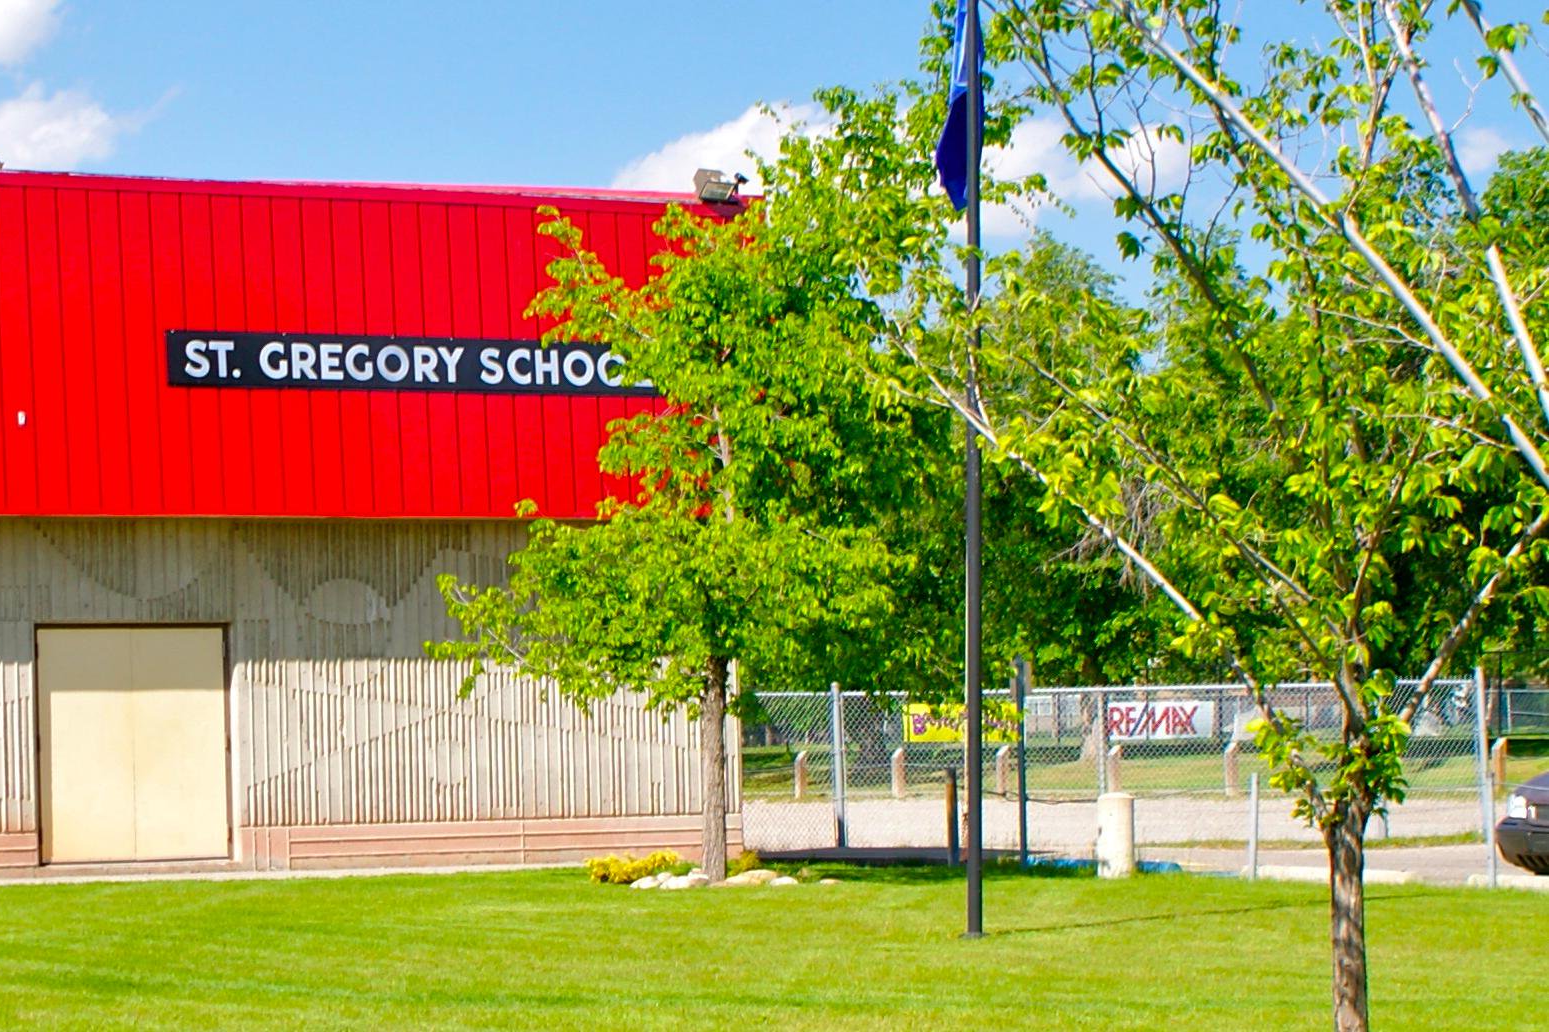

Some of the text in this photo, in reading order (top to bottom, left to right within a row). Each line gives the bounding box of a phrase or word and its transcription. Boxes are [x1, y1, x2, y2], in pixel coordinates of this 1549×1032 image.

[184, 340, 654, 388] ST. GREGORY SCHOO
[1108, 702, 1199, 737] RE/MAX
